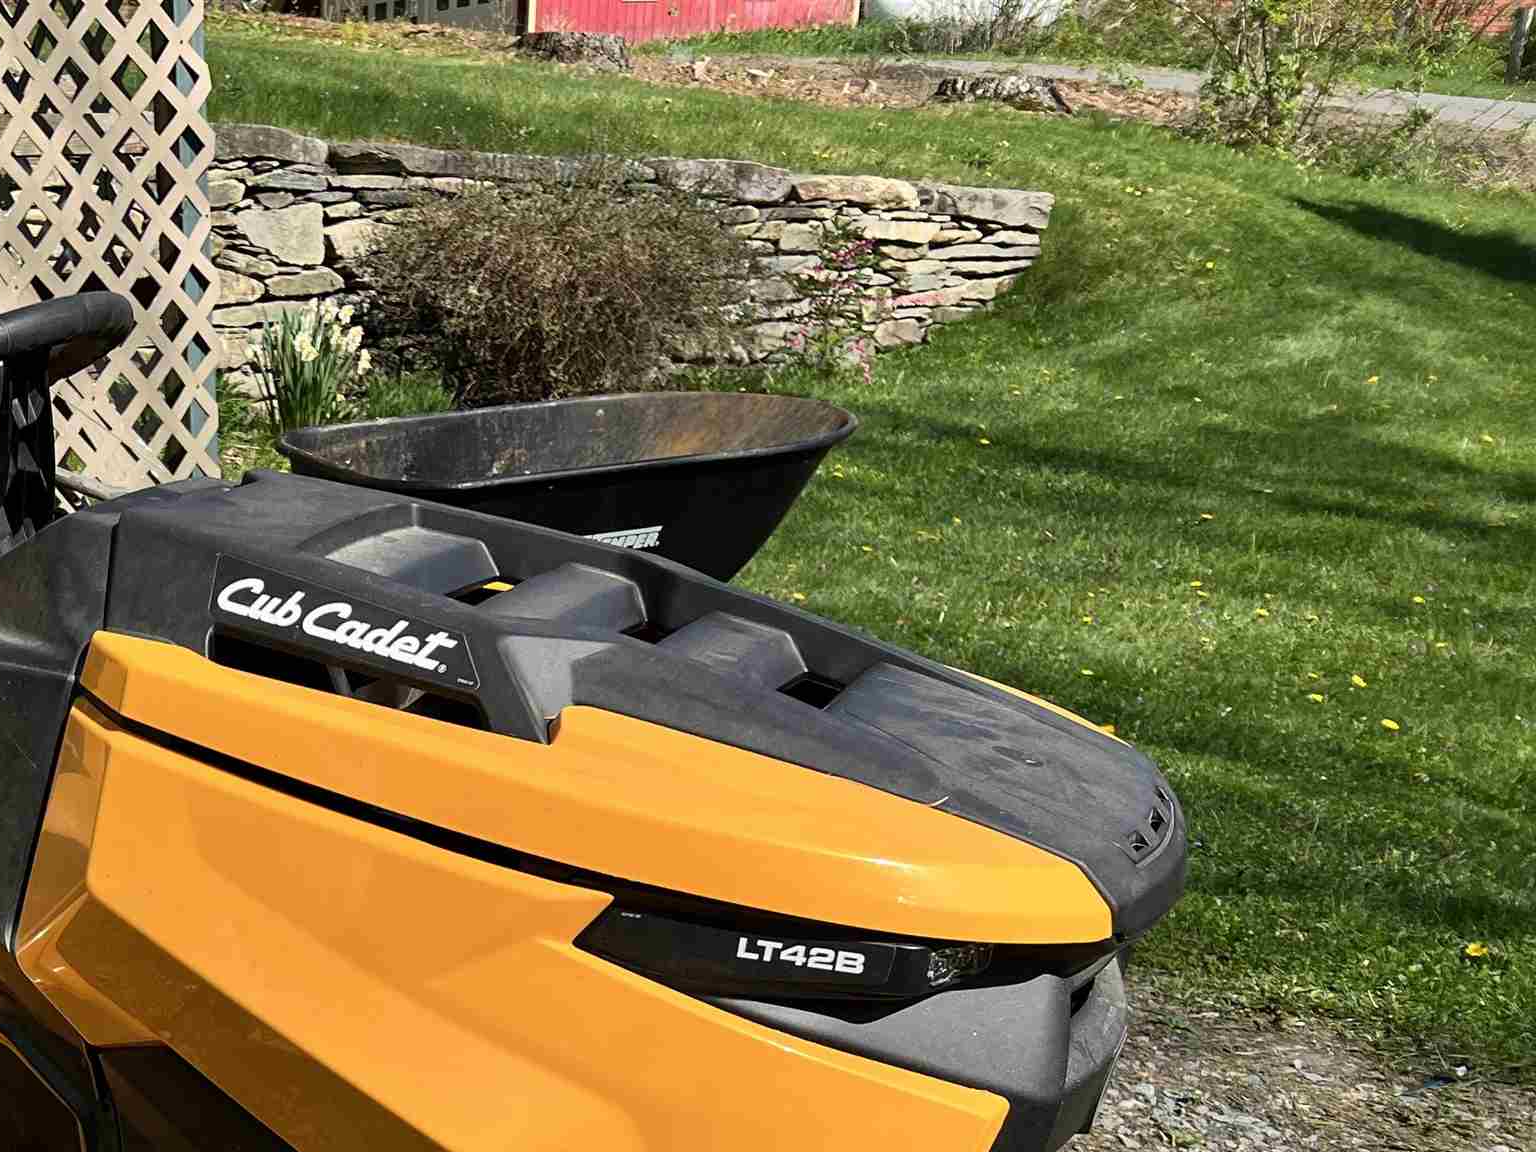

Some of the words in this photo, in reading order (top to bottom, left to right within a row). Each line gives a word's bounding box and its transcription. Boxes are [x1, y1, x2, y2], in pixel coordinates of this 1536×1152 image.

[217, 578, 305, 627] Cub
[302, 602, 458, 671] Cadet
[736, 937, 864, 975] LT42B
